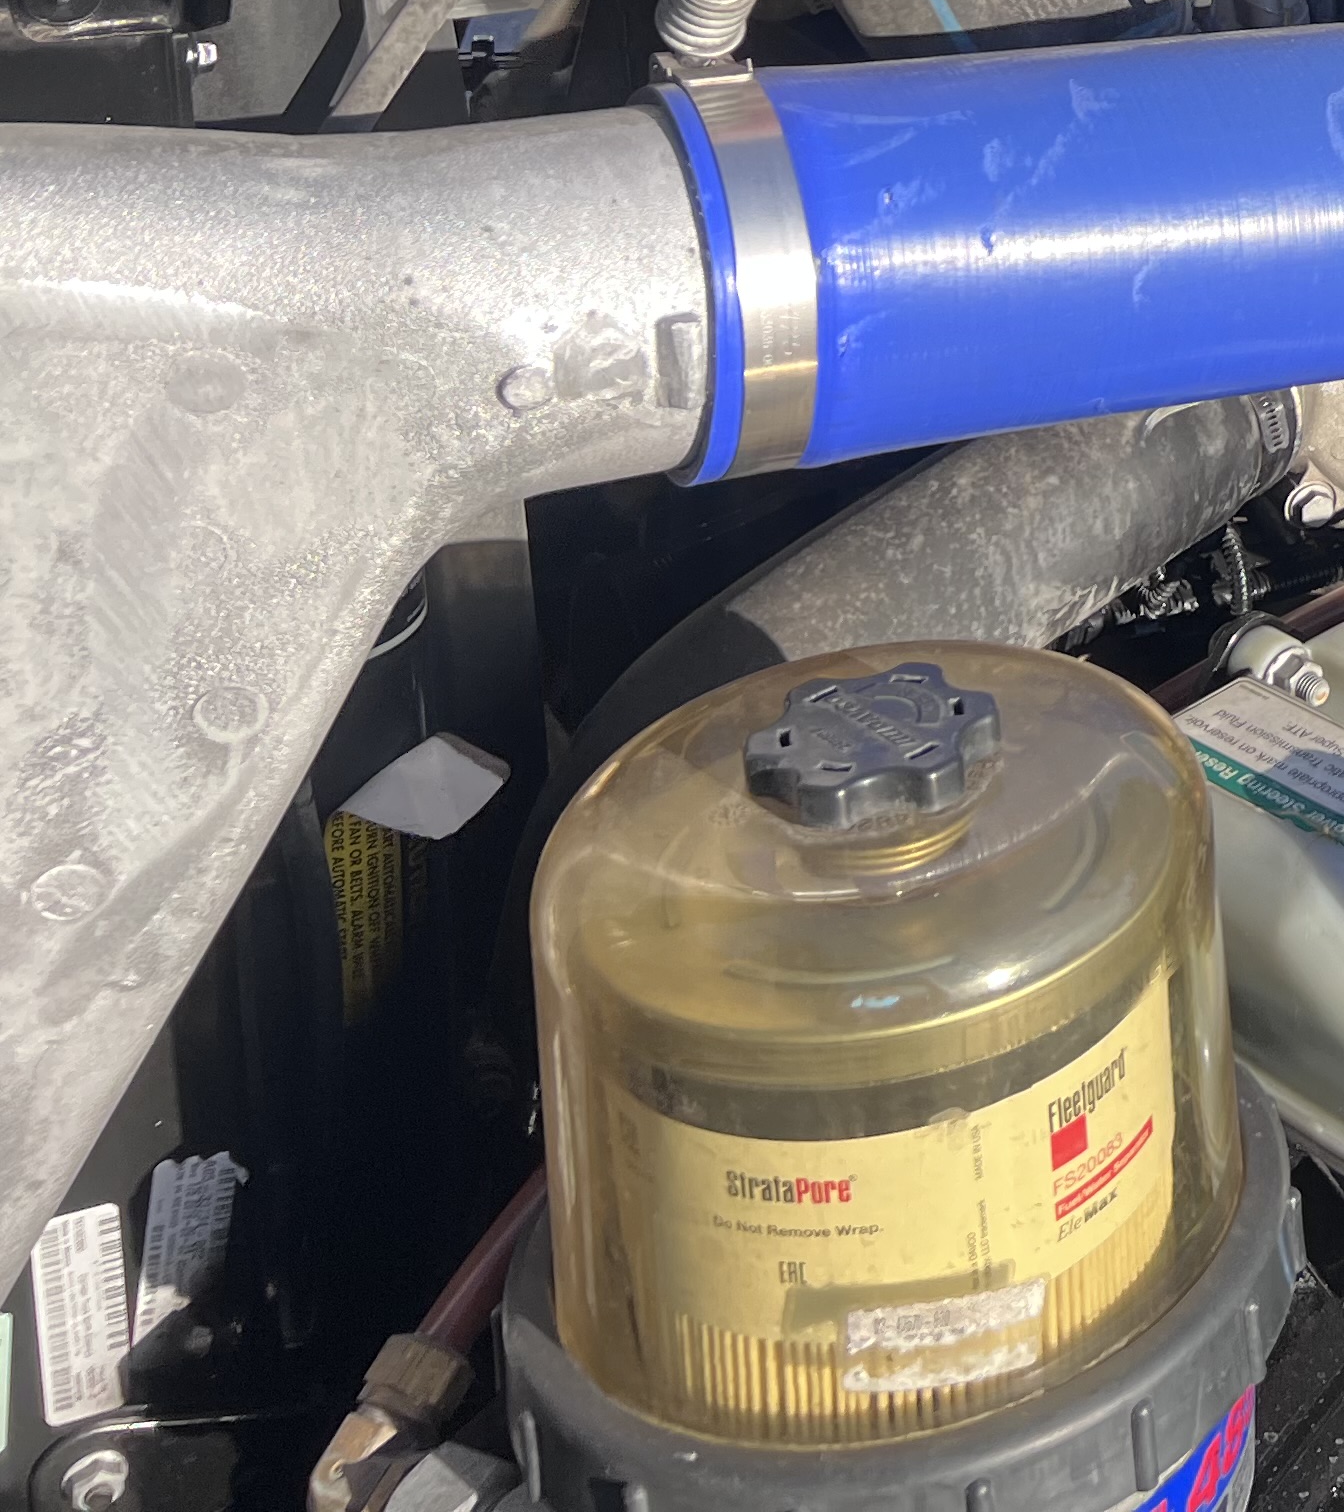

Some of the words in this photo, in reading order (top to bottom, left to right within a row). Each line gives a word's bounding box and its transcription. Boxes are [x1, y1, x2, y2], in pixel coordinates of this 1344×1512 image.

[1213, 709, 1244, 729] Fluid
[1237, 743, 1252, 755] on
[1246, 725, 1323, 767] Transmission
[1256, 751, 1286, 772] mark
[1238, 774, 1306, 816] Steering
[350, 819, 362, 846] FAN
[350, 848, 362, 866] OR
[332, 857, 347, 925] AUTOMATIC
[367, 854, 379, 909] IGNITION
[351, 910, 365, 953] ALARM
[1048, 1046, 1128, 1133] Fleetguard
[1053, 1132, 1123, 1197] FS20083
[712, 1214, 733, 1229] Do
[736, 1219, 763, 1235] Not
[767, 1223, 833, 1238] Remove
